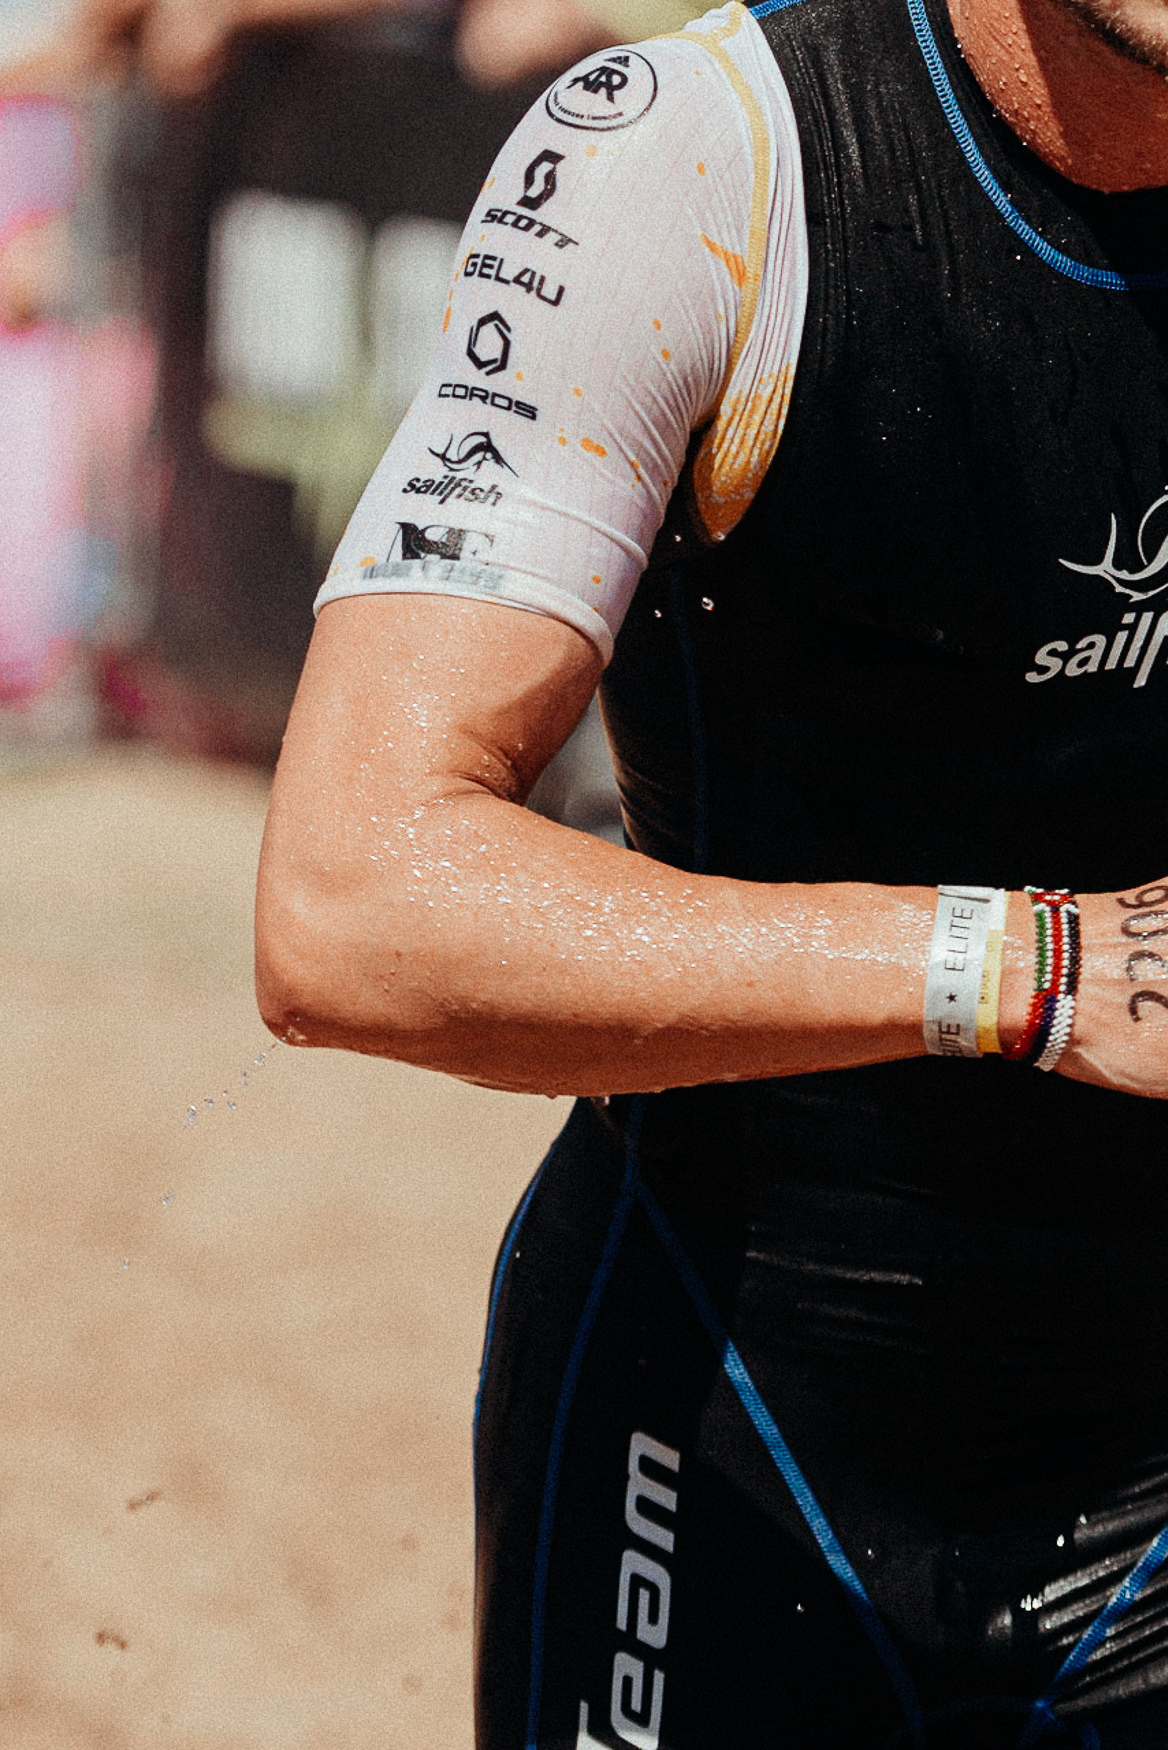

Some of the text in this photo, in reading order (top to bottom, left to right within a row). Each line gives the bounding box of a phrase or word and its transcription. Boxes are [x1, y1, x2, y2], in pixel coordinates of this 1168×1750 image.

[480, 207, 580, 250] SCOTT
[462, 253, 566, 308] GEL4U
[437, 382, 538, 422] COROS
[401, 473, 504, 508] sailfish
[944, 905, 974, 973] ELITE
